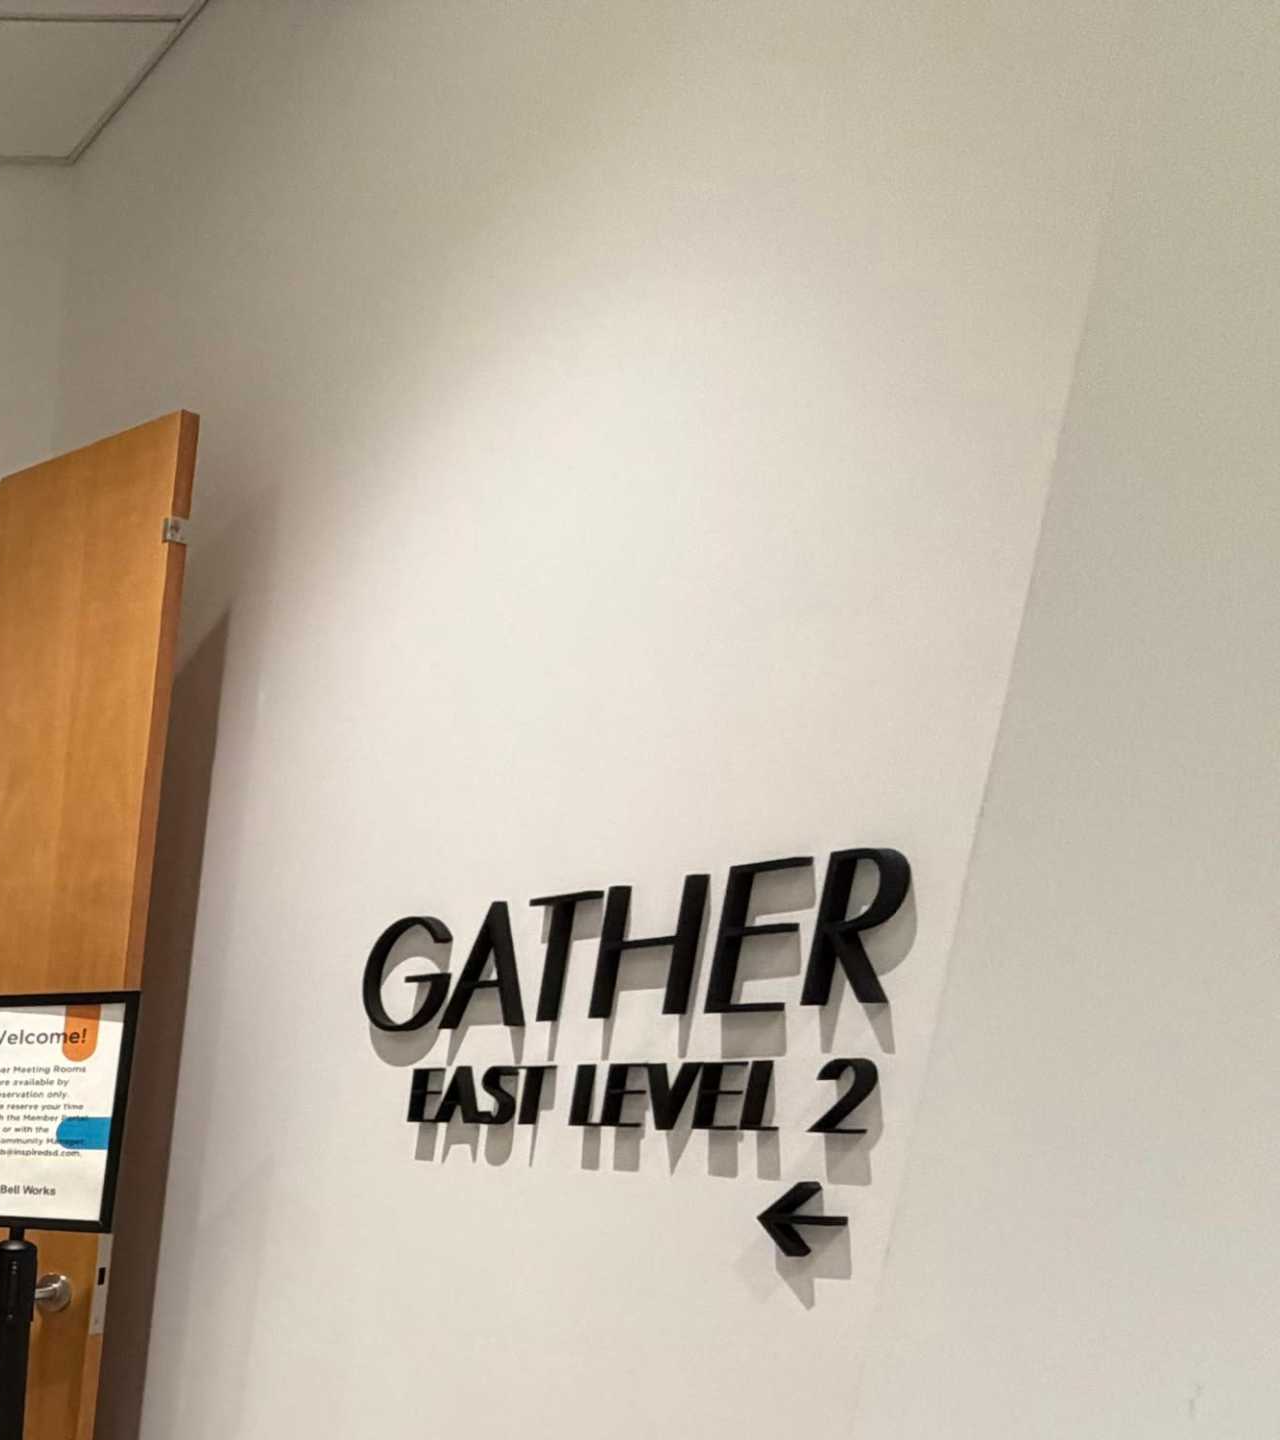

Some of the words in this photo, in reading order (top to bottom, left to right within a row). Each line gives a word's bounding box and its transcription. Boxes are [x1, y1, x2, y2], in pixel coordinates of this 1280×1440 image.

[363, 848, 912, 1031] GATHER
[13, 1065, 51, 1075] Meeting
[53, 1065, 87, 1073] Rooms
[12, 1078, 55, 1086] available
[57, 1078, 70, 1087] by
[406, 1064, 557, 1125] EAST
[568, 1060, 779, 1131] LEVEL
[806, 1058, 880, 1135] 2
[41, 1104, 61, 1112] your
[0, 1184, 20, 1194] Bell
[22, 1184, 56, 1196] Works
